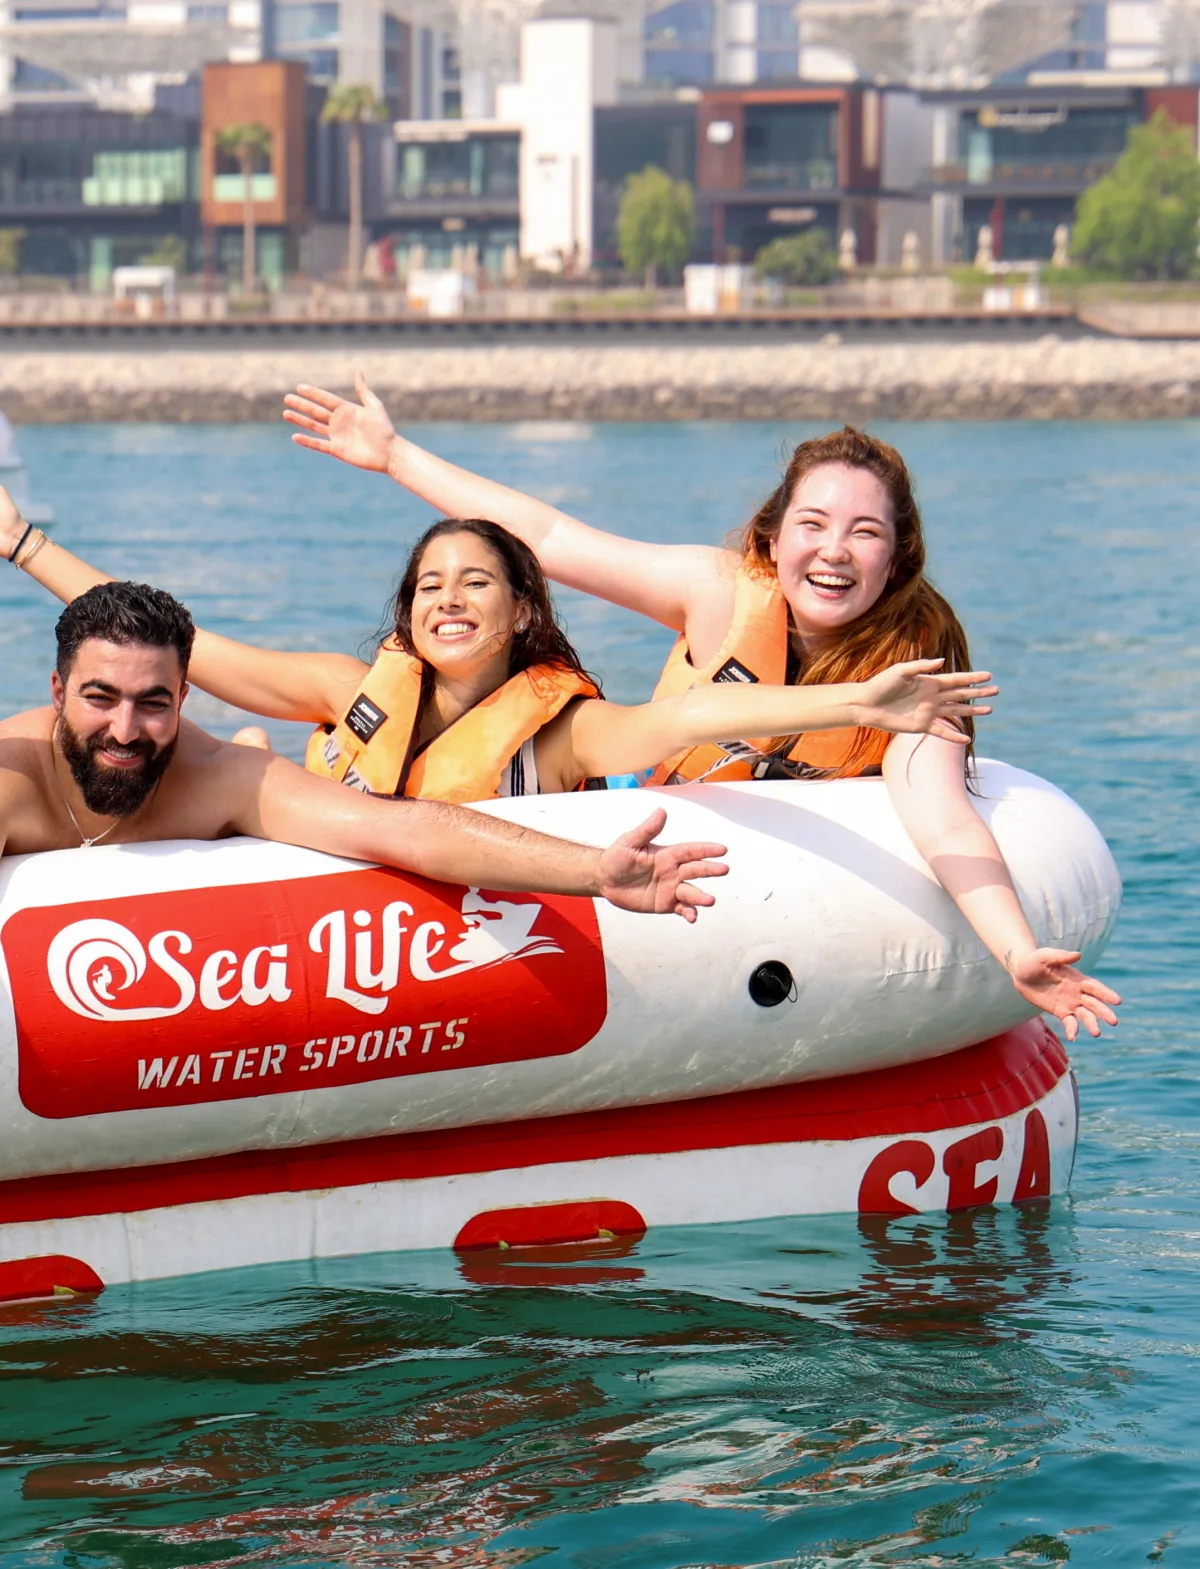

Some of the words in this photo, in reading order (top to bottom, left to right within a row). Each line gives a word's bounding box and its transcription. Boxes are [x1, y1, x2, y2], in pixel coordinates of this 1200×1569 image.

[140, 930, 292, 1020] Sea
[309, 901, 452, 1015] Life
[138, 1045, 287, 1090] WATER
[299, 1018, 468, 1071] SPORTS
